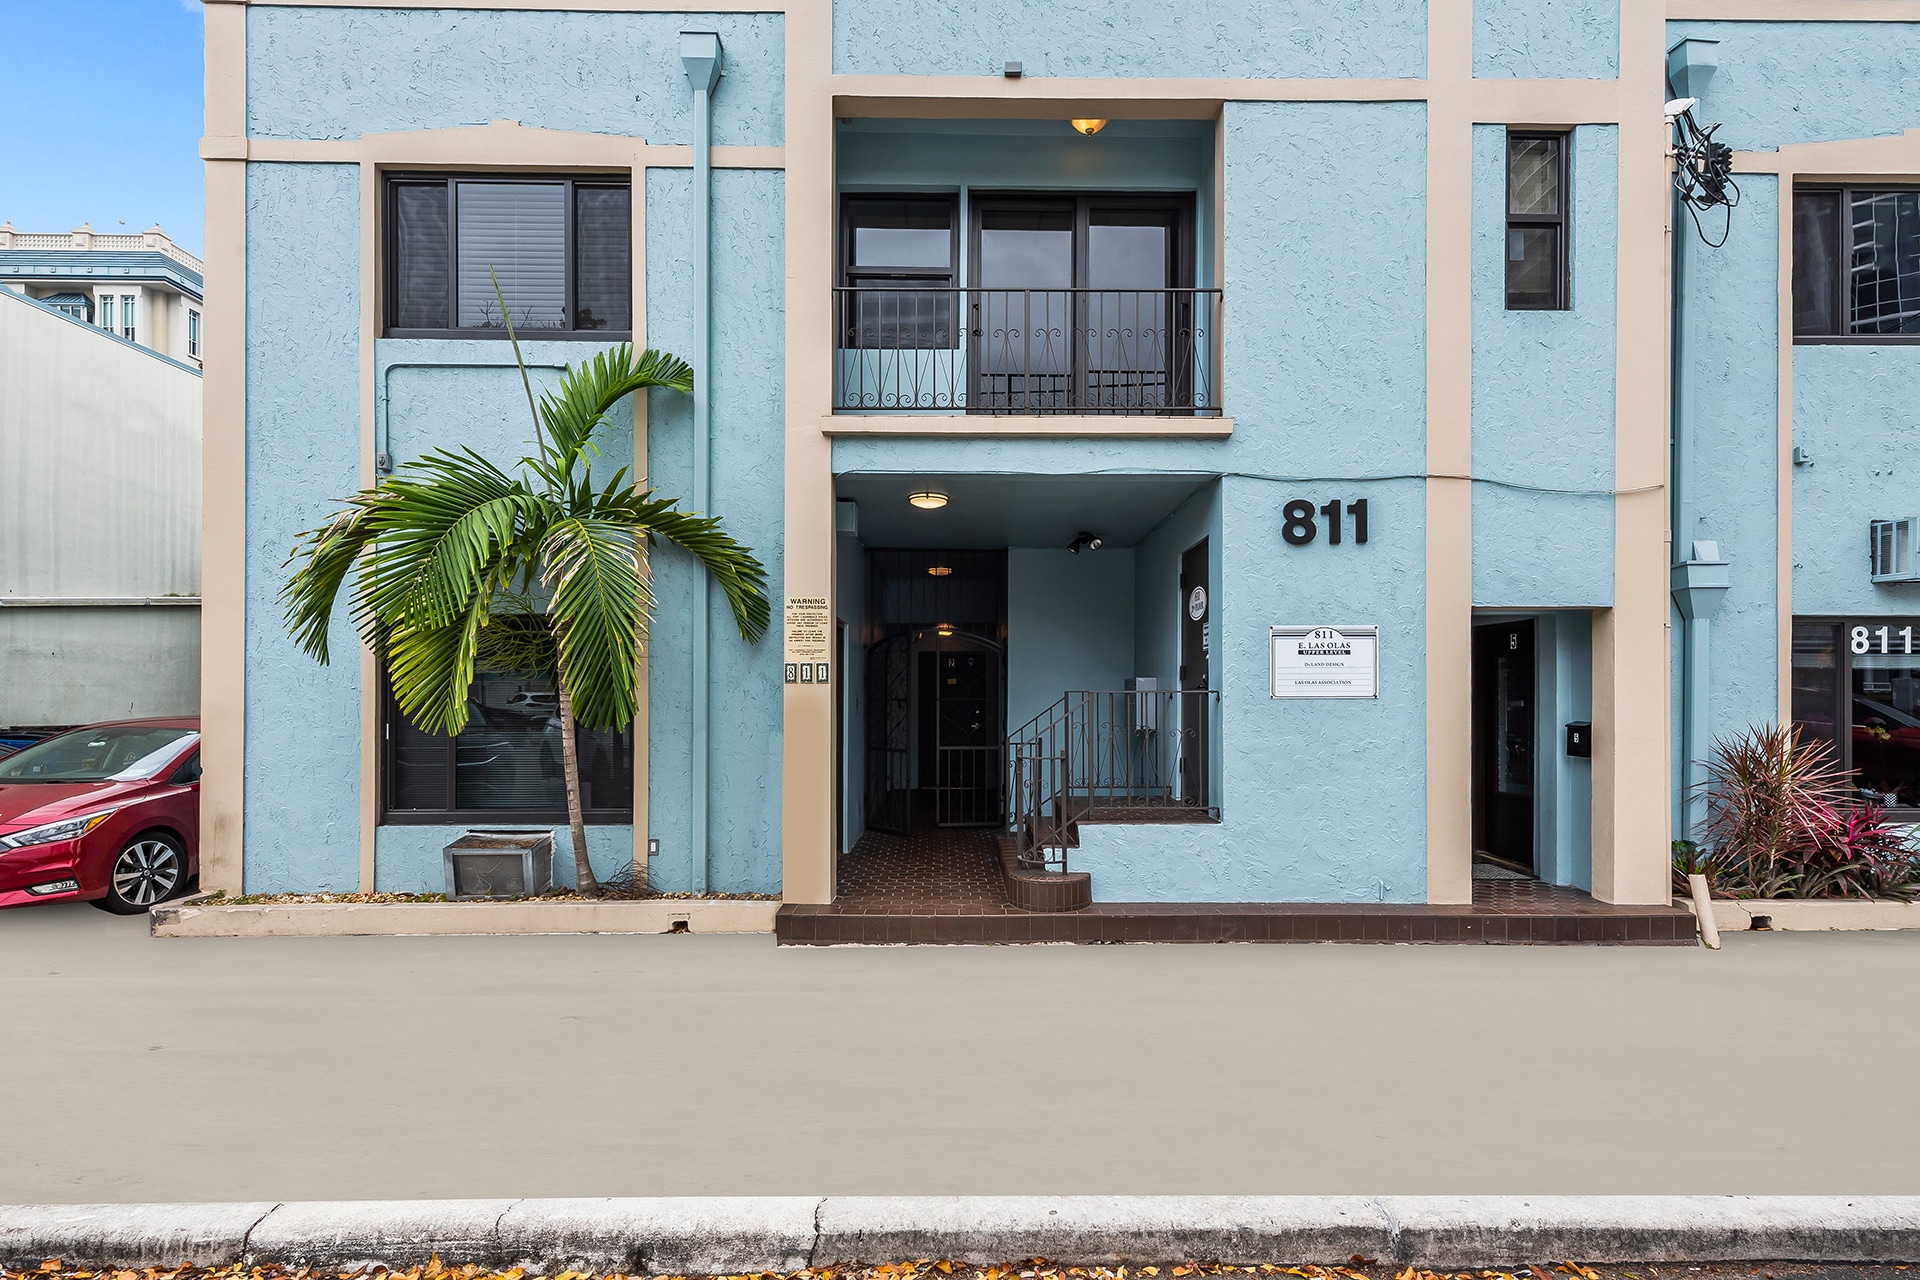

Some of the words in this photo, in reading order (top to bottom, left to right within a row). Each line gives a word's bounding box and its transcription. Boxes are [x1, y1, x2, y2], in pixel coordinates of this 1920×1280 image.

[1281, 498, 1368, 545] 811
[1314, 630, 1333, 639] 811
[1510, 633, 1517, 650] 5
[1851, 626, 1912, 654] 811
